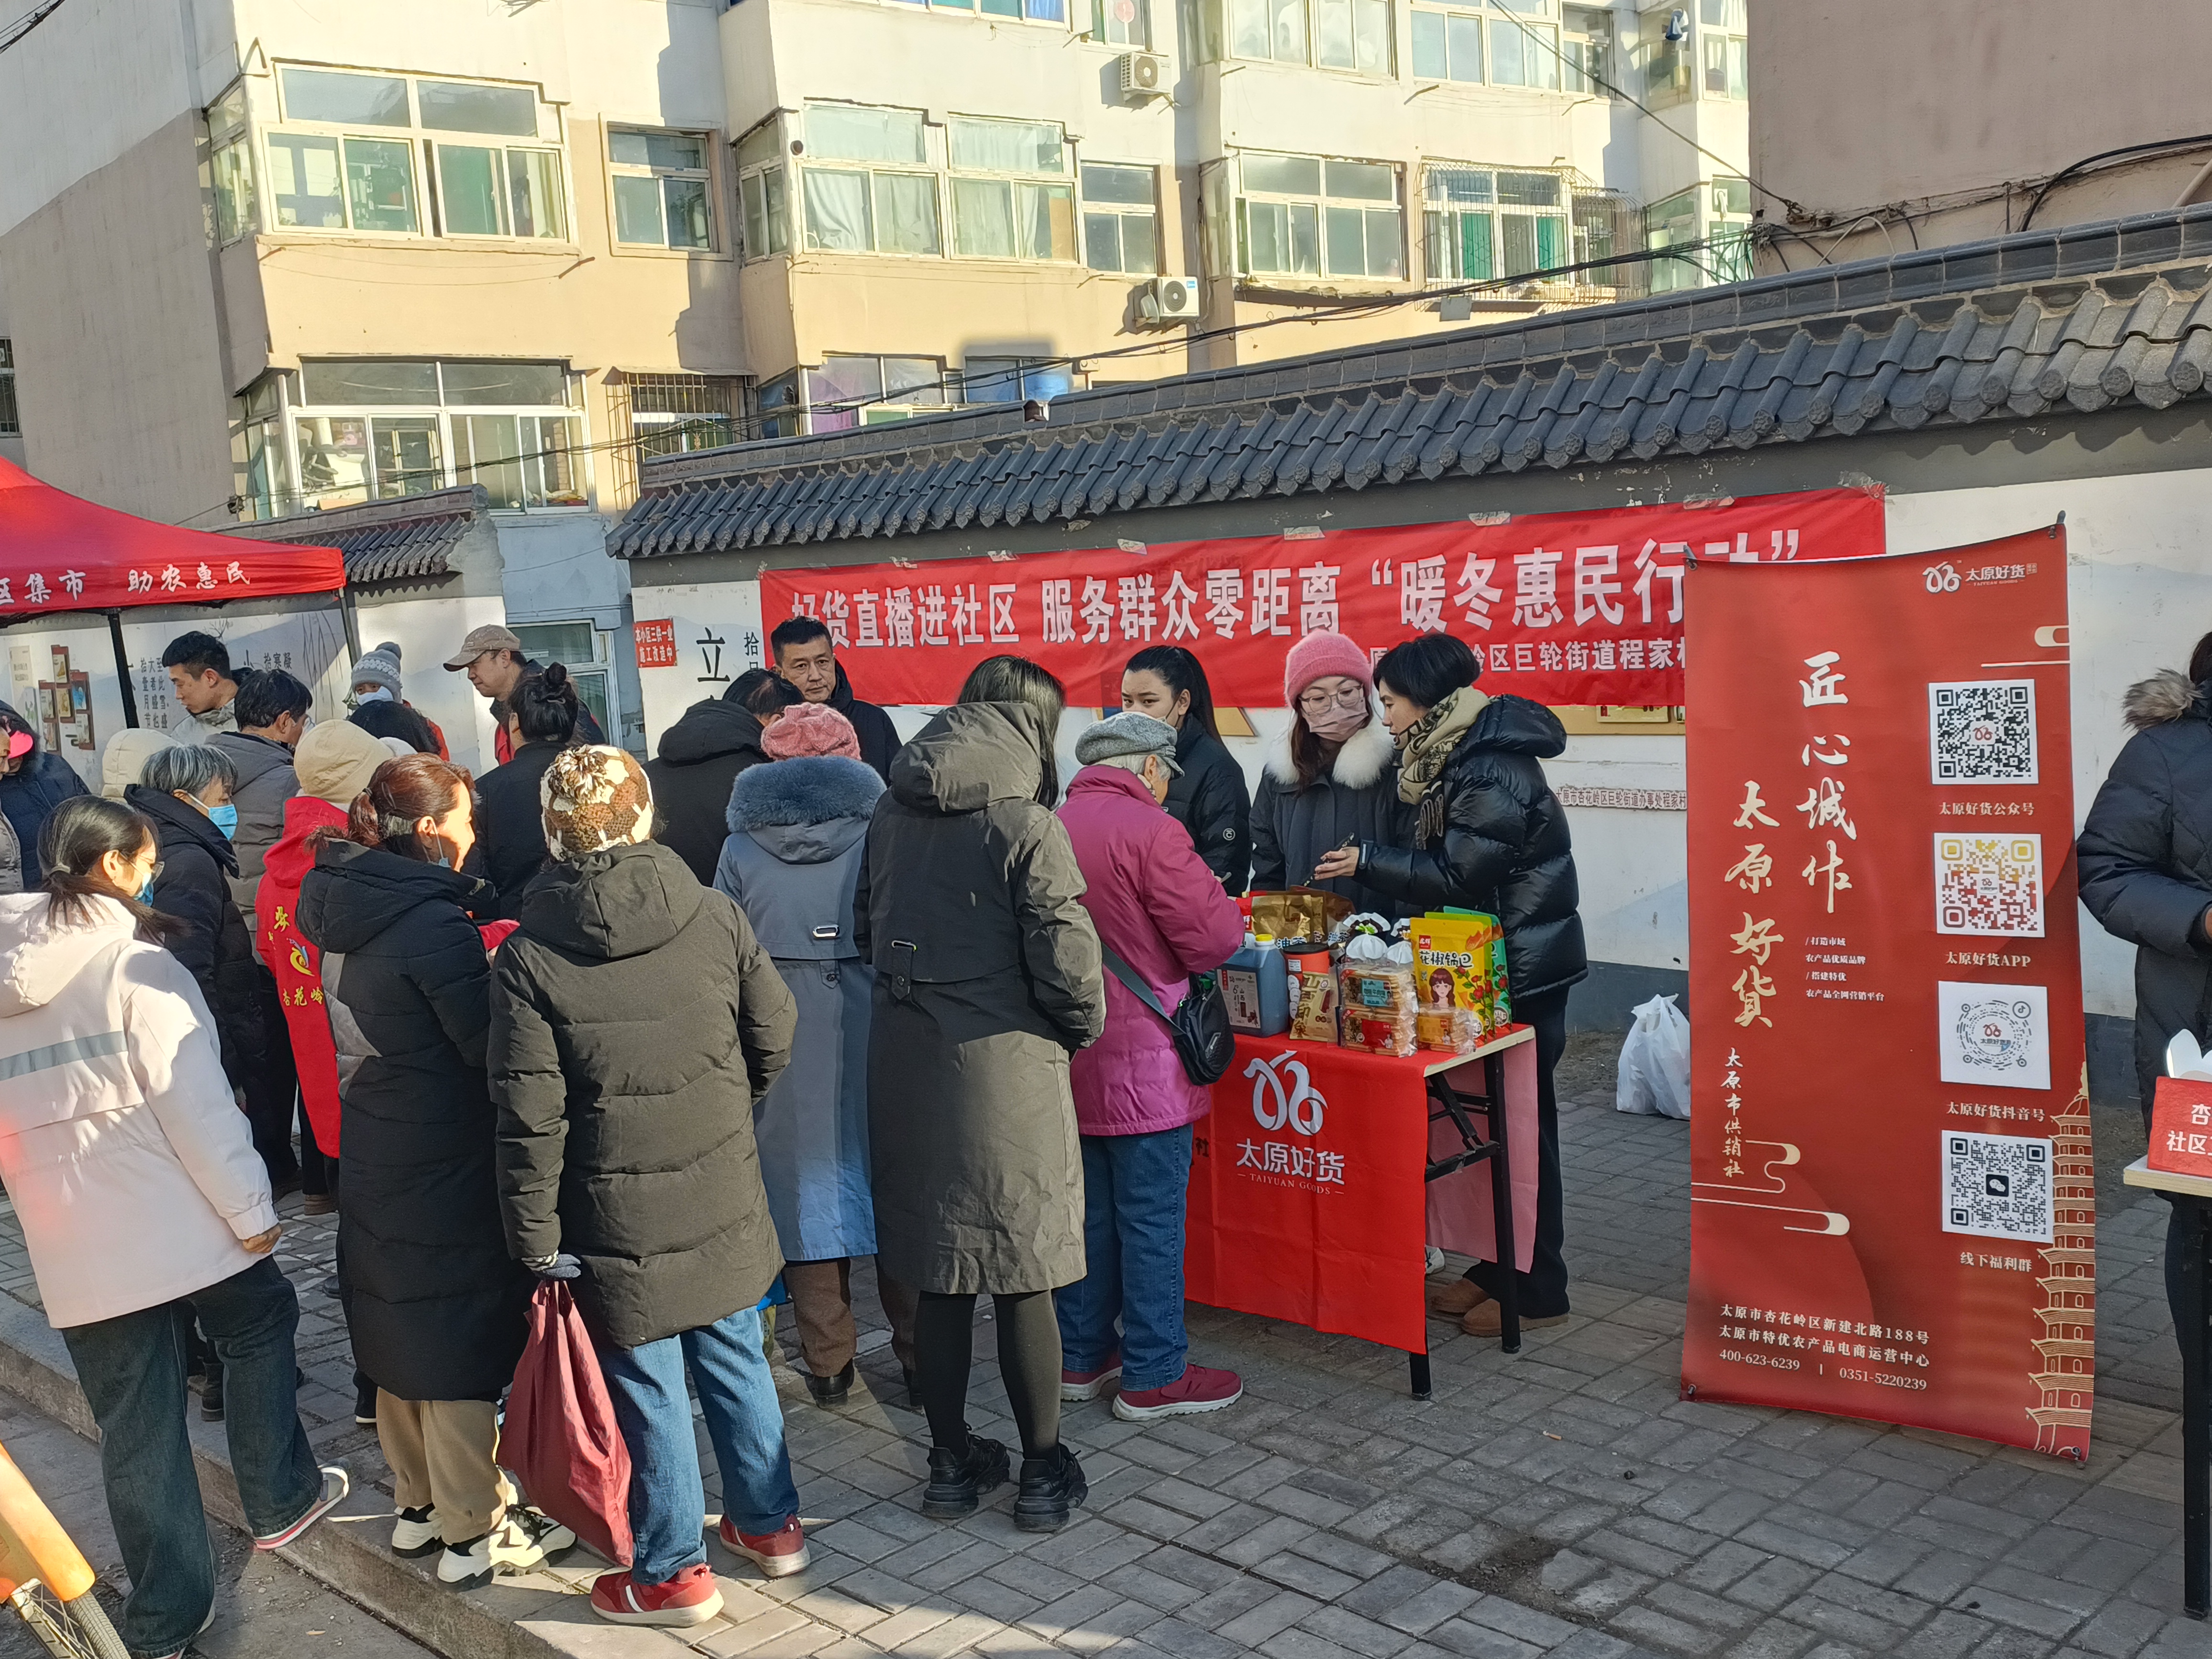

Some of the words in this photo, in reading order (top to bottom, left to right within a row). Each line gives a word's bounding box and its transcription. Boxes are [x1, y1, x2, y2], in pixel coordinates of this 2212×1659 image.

[128, 561, 250, 594] 助农惠民
[1965, 564, 2025, 582] 太原好货
[792, 583, 1019, 648] 好货直播进社区
[1041, 561, 1341, 643] 服务群众零距离
[696, 627, 730, 682] 立
[1939, 802, 2035, 816] 太原好货公众号
[1419, 951, 1473, 967] 花椒锅巴
[1805, 953, 1866, 965] 农产品优质品牌
[1945, 951, 2031, 967] 太原好货APP
[283, 985, 324, 1006] 杏花岭
[1806, 988, 1885, 1002] 农产品全网营销平台
[1721, 1047, 1745, 1178] 太原市供销社
[1946, 1101, 2046, 1122] 太原好货抖音号
[2191, 1103, 2212, 1126] 杏
[1237, 1138, 1345, 1185] 太原好货
[1250, 1173, 1295, 1188] TAIYUAN
[1299, 1182, 1331, 1195] GOODS
[1960, 1251, 2033, 1272] 线下福利群
[1720, 1304, 1930, 1345] 太原市杏花岭区新建北路188号
[1718, 1325, 1930, 1367] 太原市特优农产品电商运营中心
[1719, 1349, 1800, 1371] 400-623-6239
[1839, 1367, 1927, 1391] 0351-5220239
